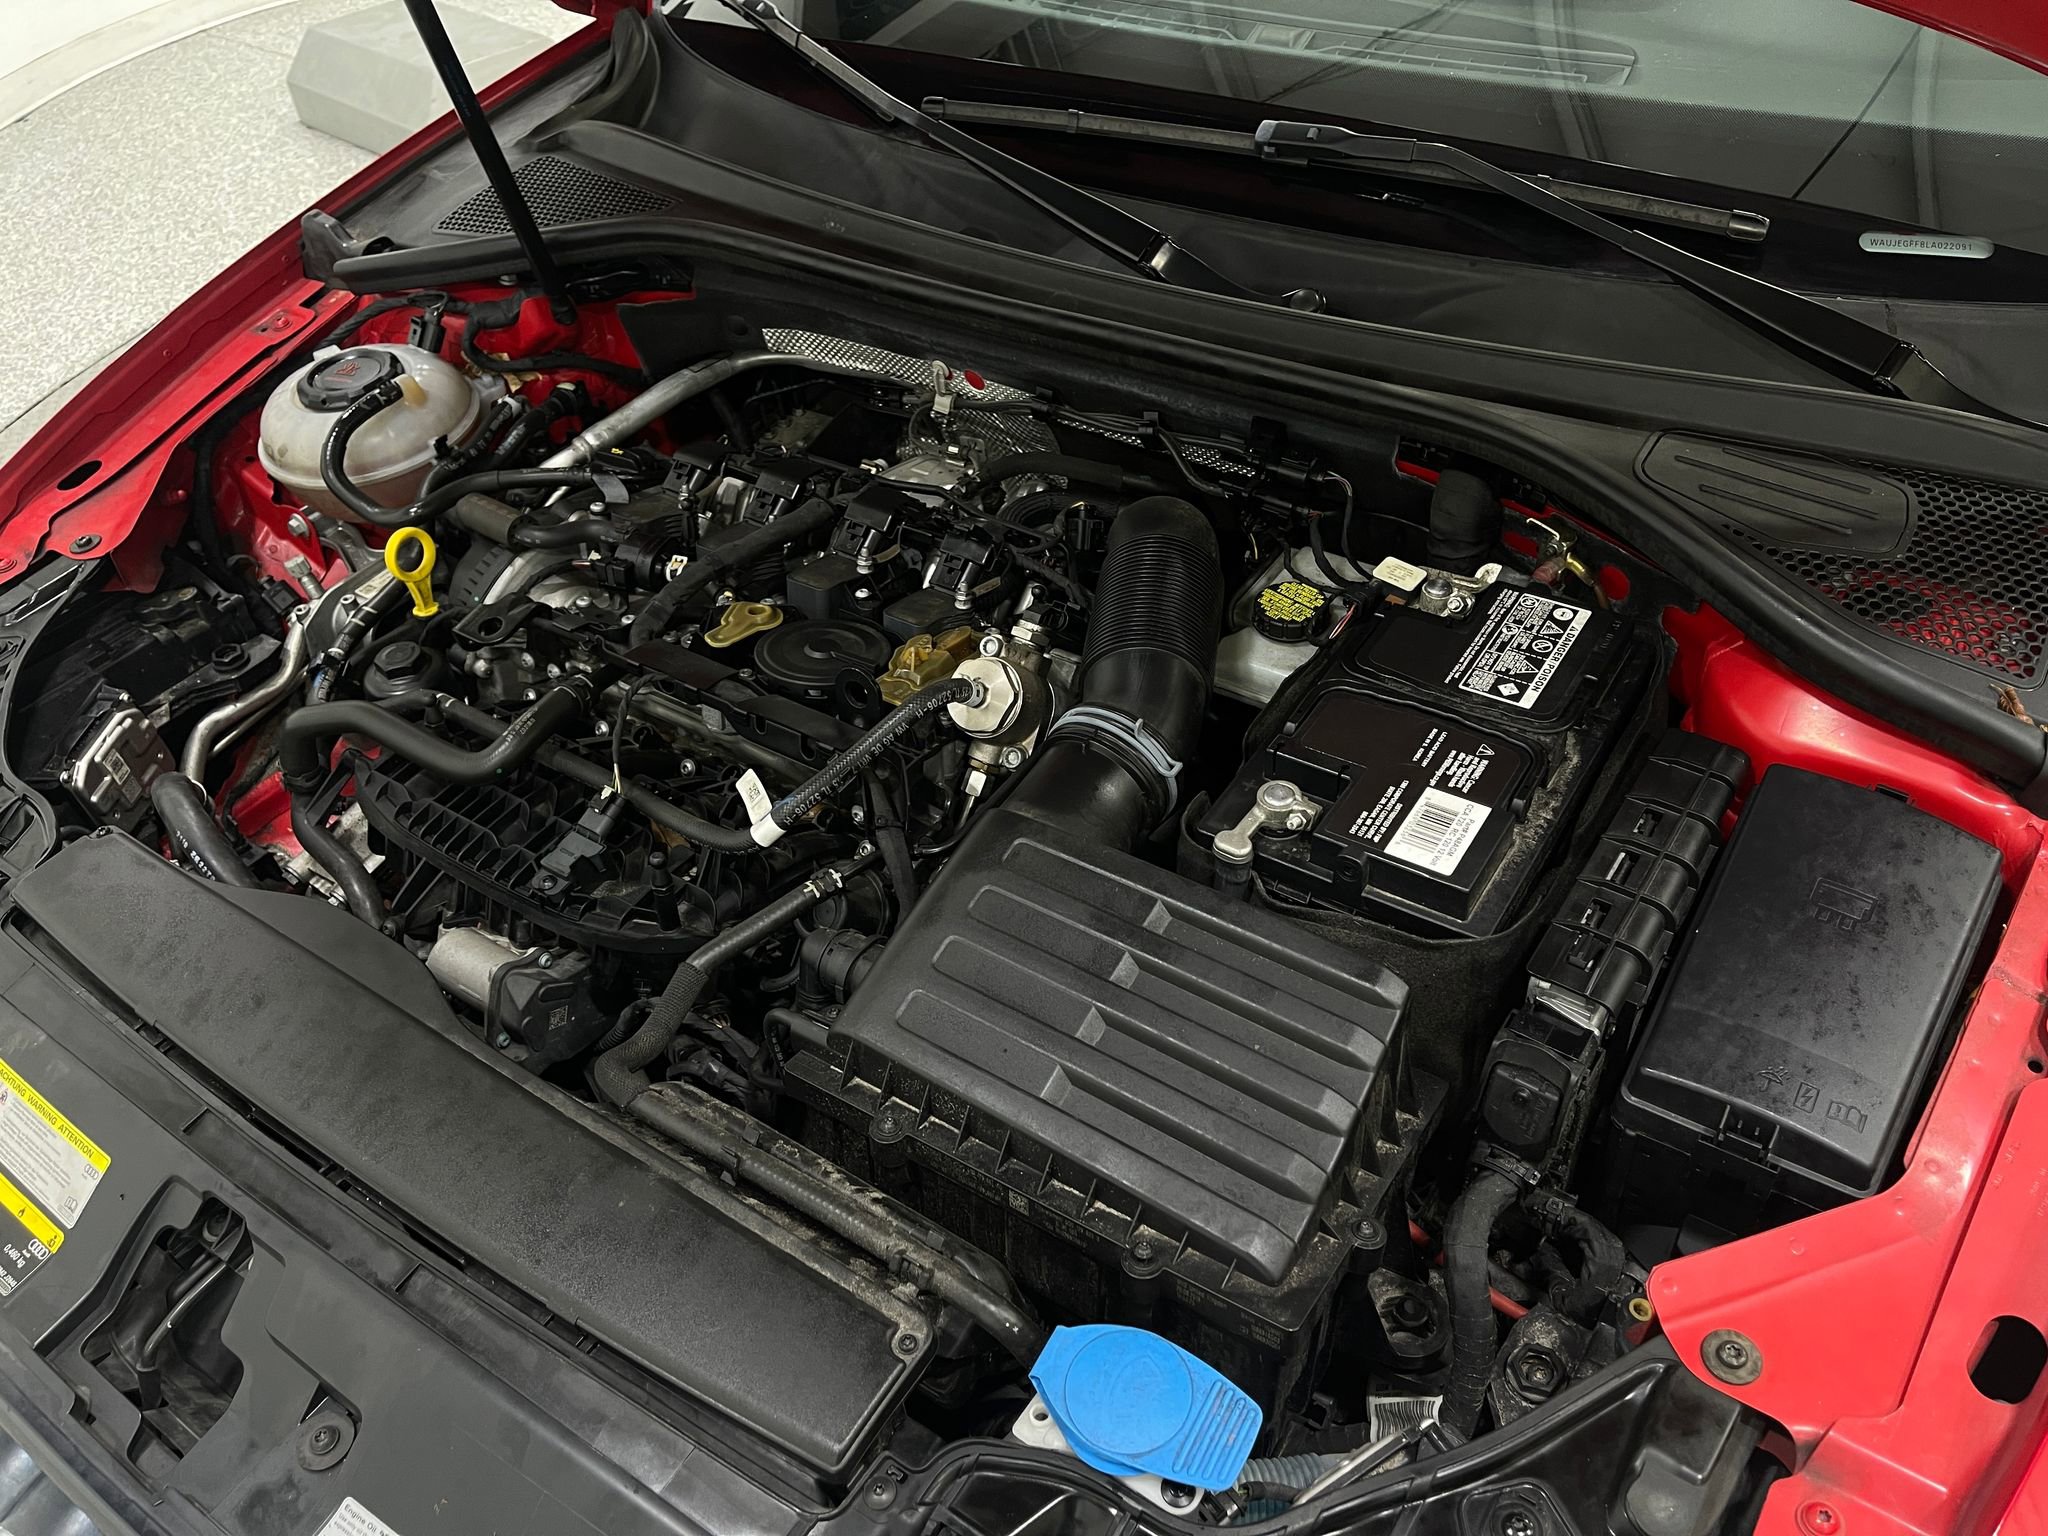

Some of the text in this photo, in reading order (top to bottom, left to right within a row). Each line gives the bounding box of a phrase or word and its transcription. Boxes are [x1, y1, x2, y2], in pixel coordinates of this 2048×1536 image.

[1461, 803, 1474, 816] CCA
[28, 1094, 58, 1126] WARNING
[58, 1122, 93, 1158] ATTENTION
[344, 1504, 366, 1526] Engine
[366, 1520, 377, 1533] Oil
